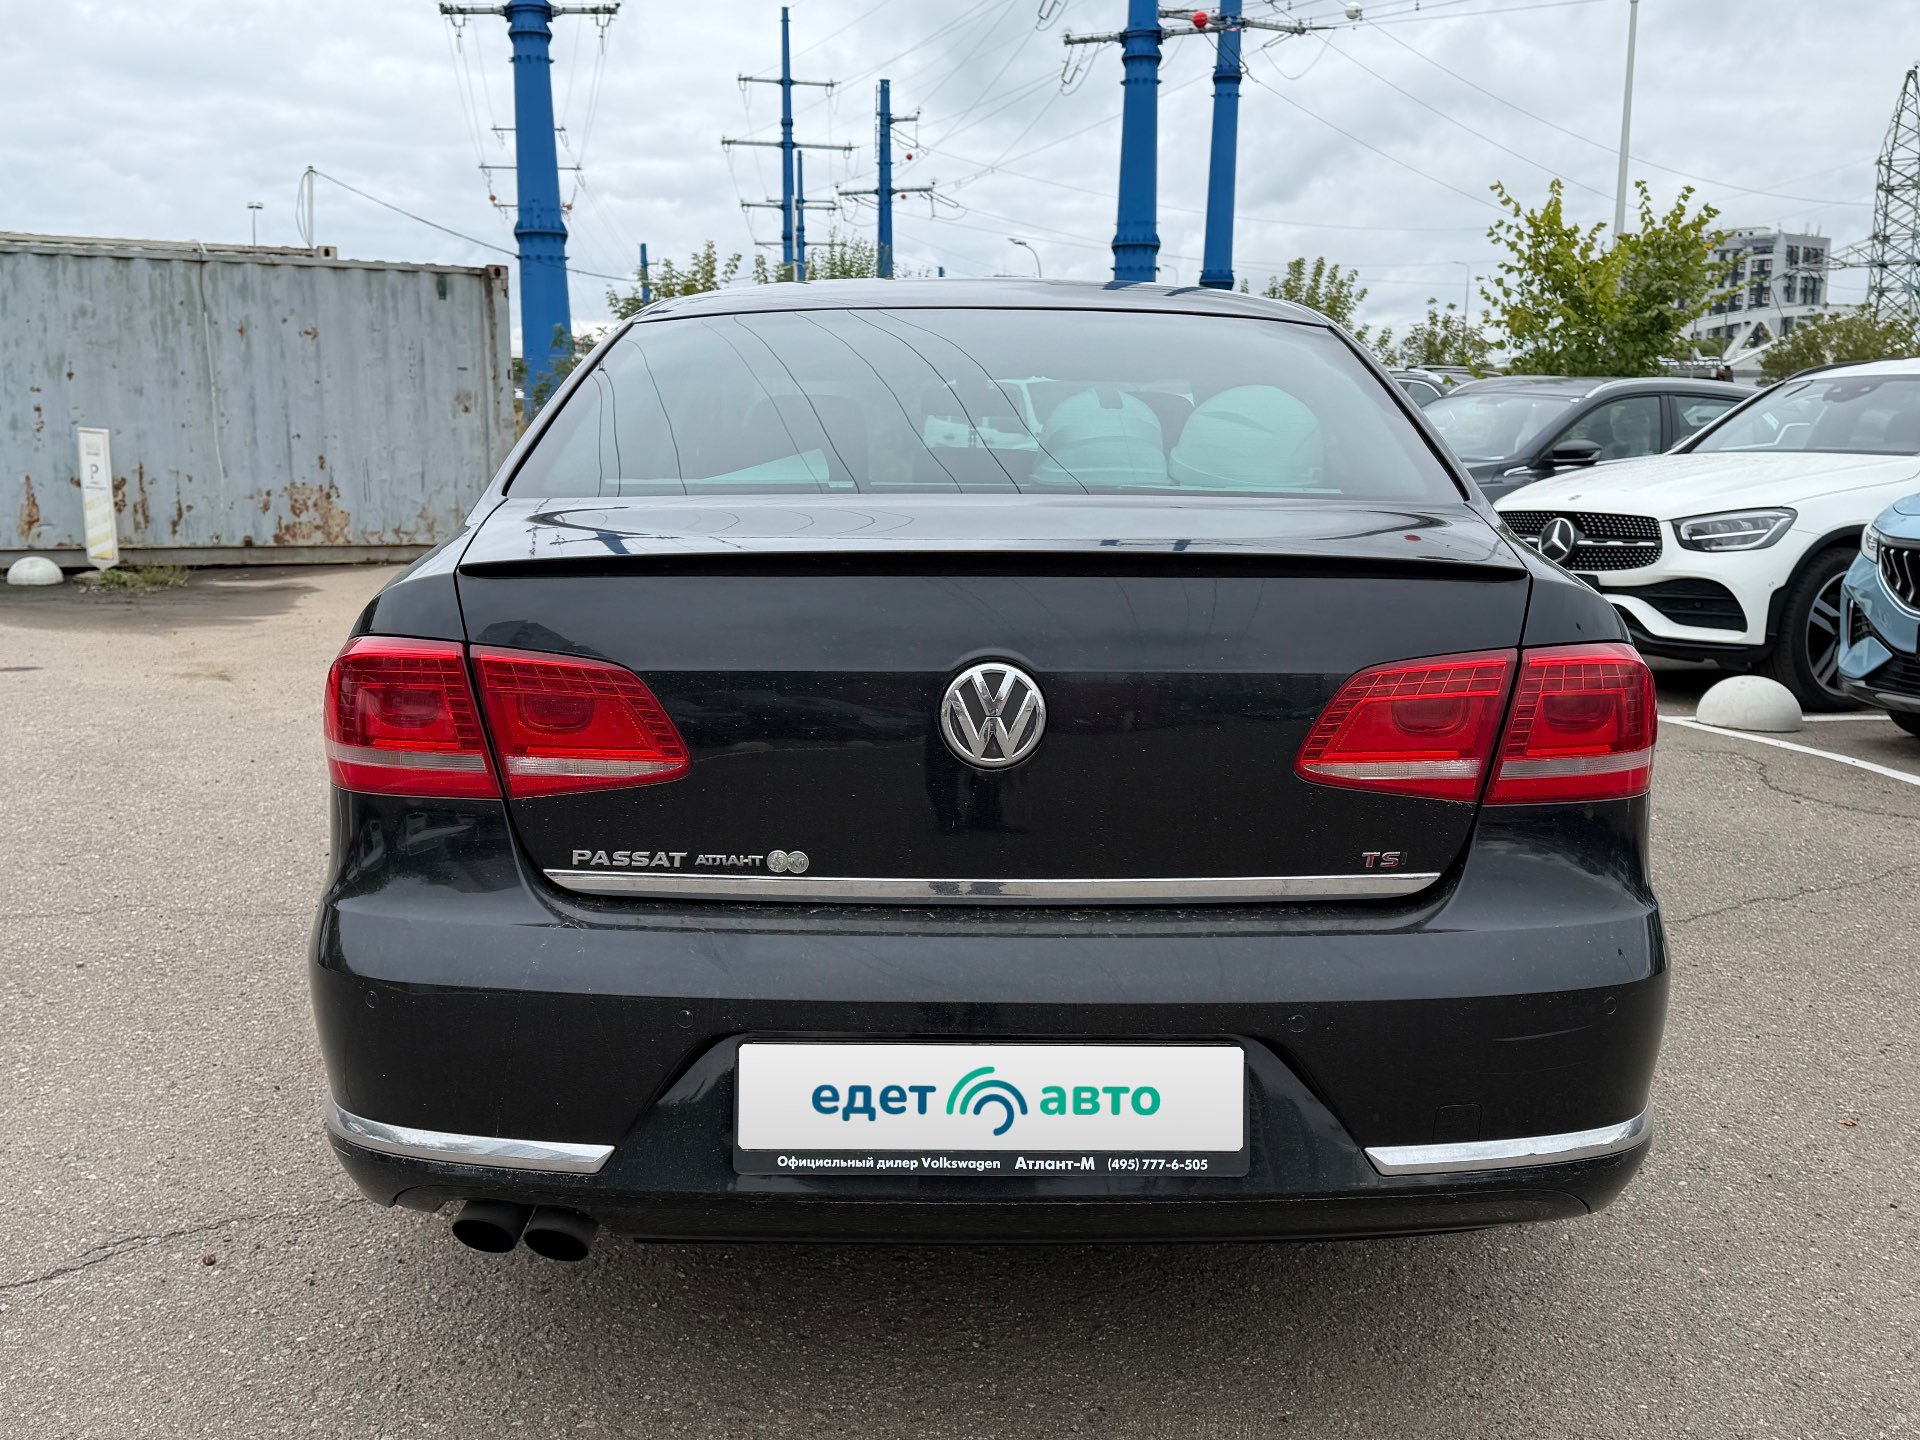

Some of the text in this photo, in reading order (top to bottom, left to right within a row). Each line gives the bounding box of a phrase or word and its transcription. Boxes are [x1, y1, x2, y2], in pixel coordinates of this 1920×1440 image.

[572, 850, 688, 868] PASSAT
[695, 854, 764, 867] АТЛАНТ
[777, 1155, 1208, 1173] Официальный дилер Volkswagen Атлант-М (495) 777-6-505
